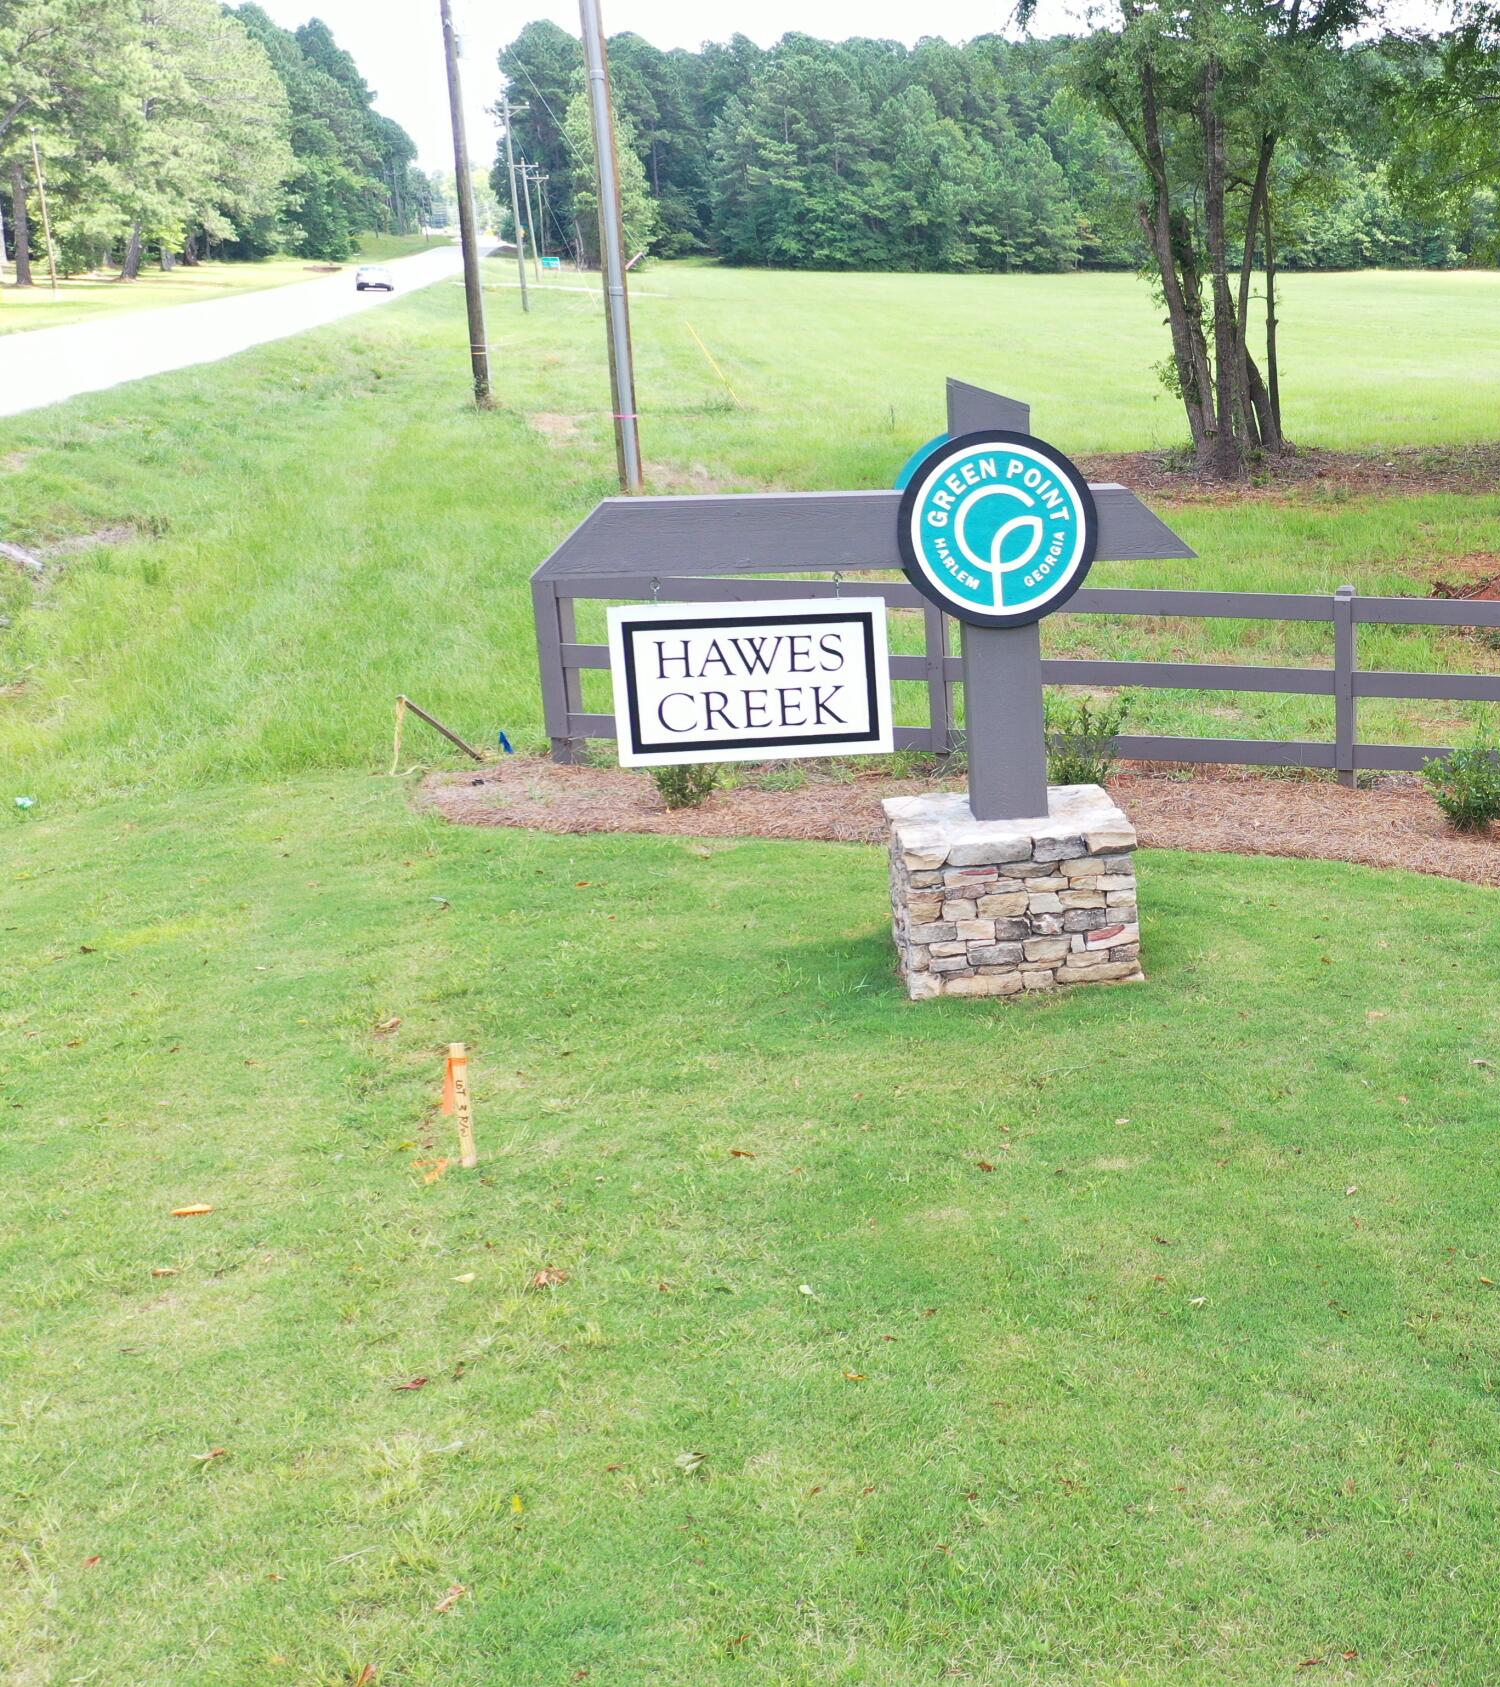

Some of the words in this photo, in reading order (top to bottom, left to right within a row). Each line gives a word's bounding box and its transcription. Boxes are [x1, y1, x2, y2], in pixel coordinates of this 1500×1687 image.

[927, 457, 997, 528] GREEN
[1006, 458, 1070, 522] POINT
[934, 537, 981, 590] HARLEM
[1023, 531, 1066, 588] GEORGIA
[653, 633, 845, 679] HAWES
[657, 685, 848, 733] CREEK
